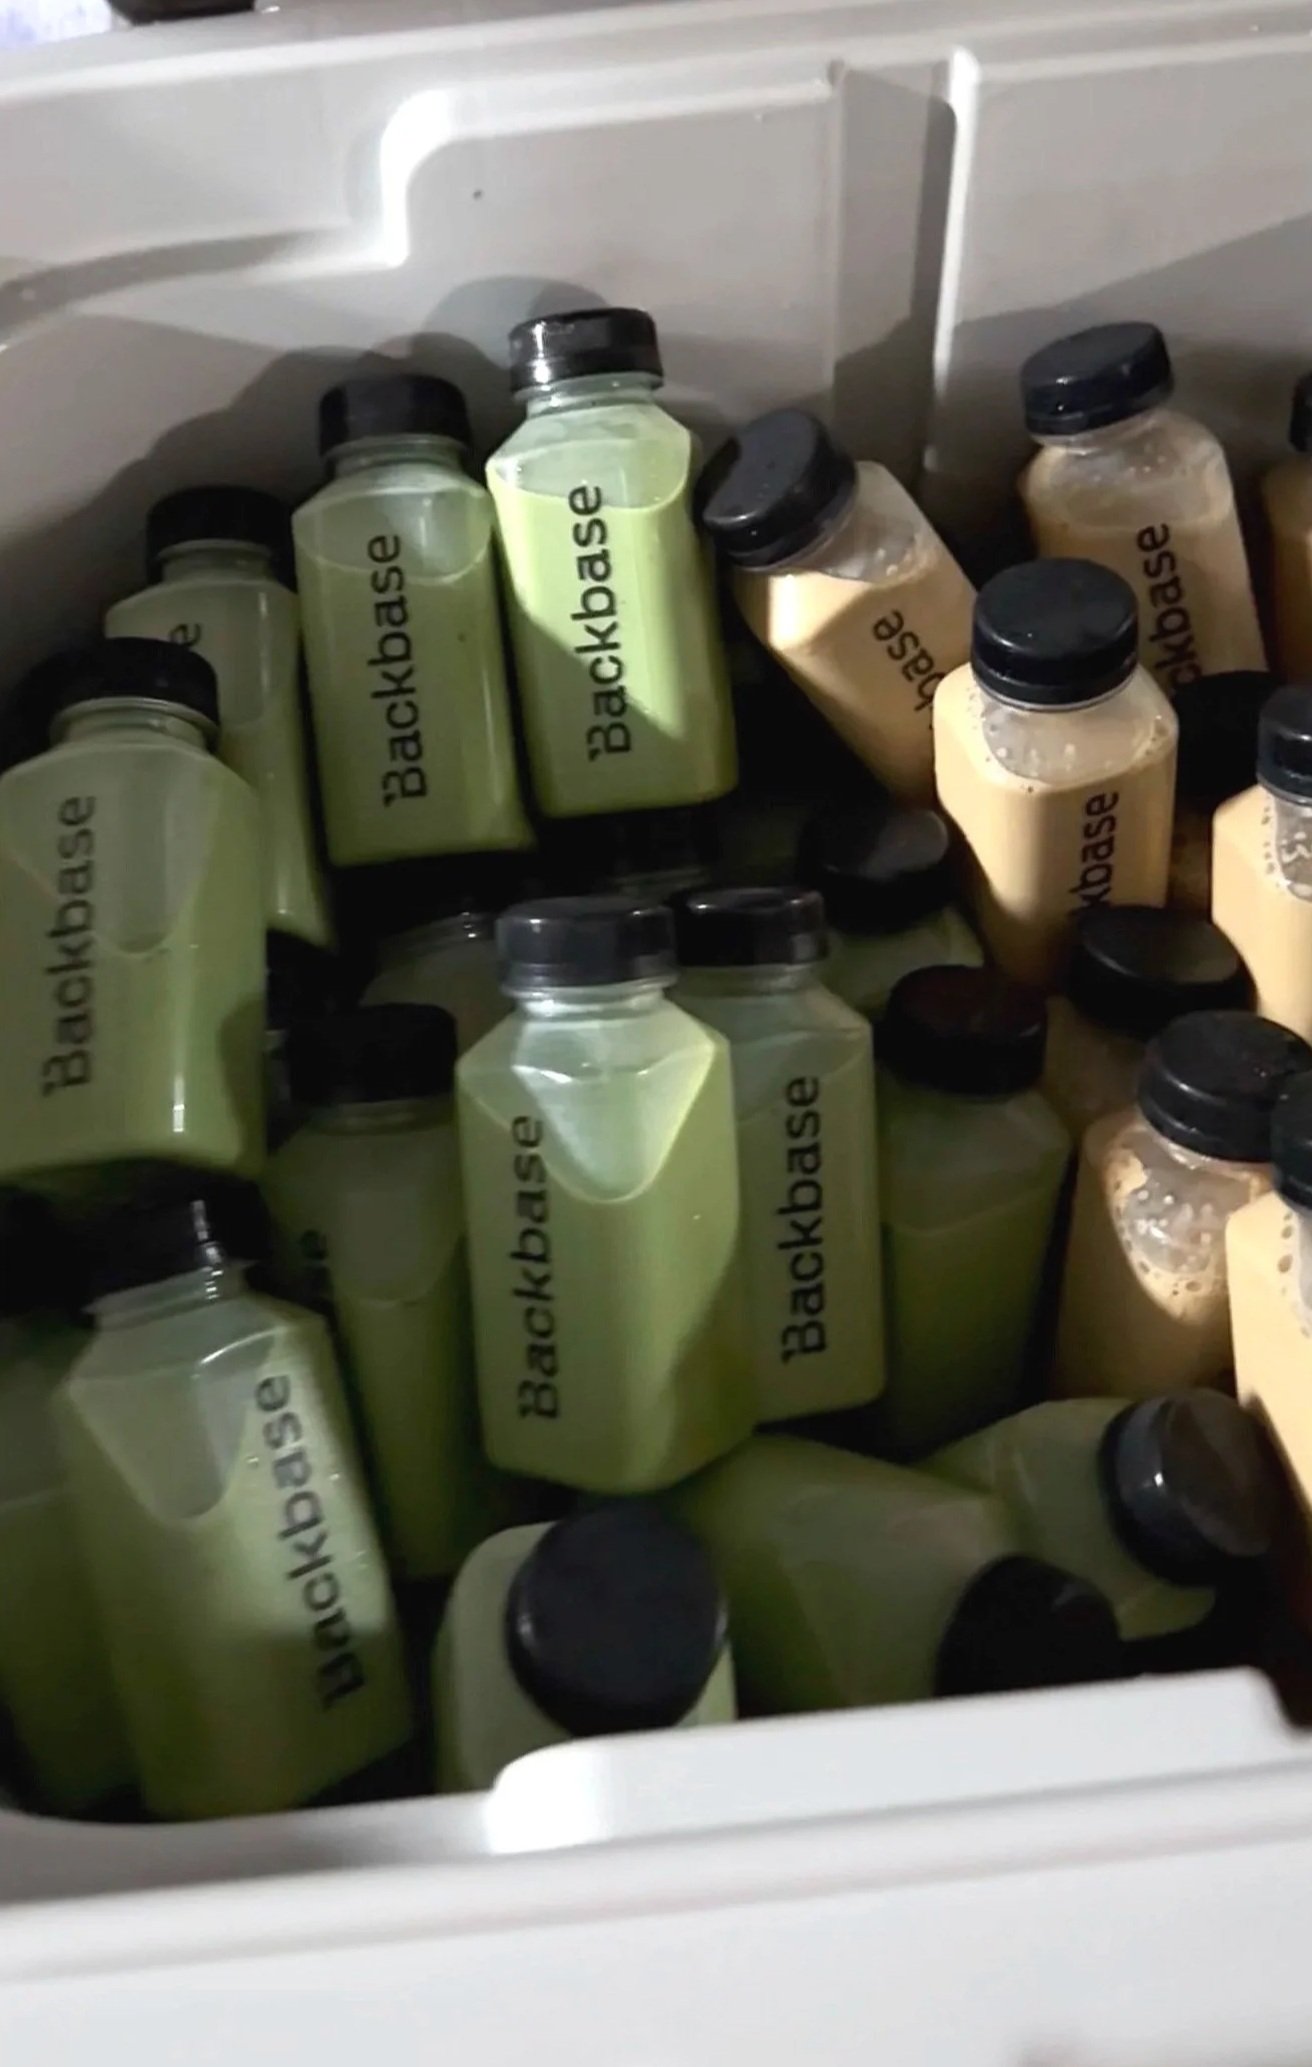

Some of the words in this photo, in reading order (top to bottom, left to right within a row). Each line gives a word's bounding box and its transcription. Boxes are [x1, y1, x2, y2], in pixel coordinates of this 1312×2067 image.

[367, 533, 427, 808] Backbase
[569, 484, 631, 762] Backbase
[872, 609, 946, 712] base
[1136, 523, 1202, 688] ckbase
[42, 794, 95, 1098] Backbase
[510, 1115, 560, 1422] Backbase
[778, 1075, 825, 1365] Backbase
[255, 1374, 365, 1711] Backbase
